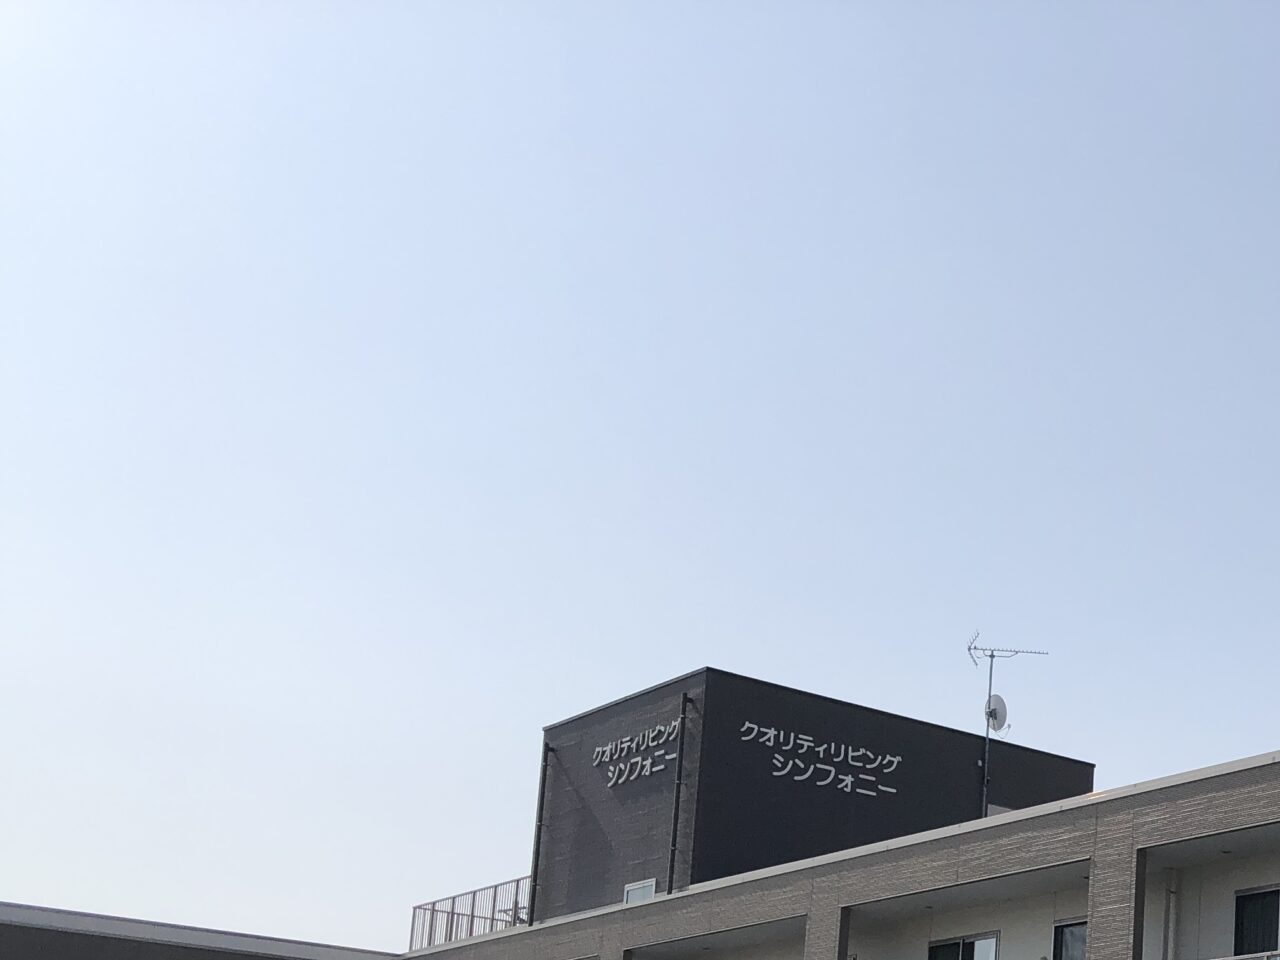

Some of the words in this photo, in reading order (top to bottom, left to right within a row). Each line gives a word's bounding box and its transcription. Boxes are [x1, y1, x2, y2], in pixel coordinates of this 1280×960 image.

[592, 717, 681, 767] クオリティリビング
[739, 720, 903, 774] クオリティリビング
[606, 750, 678, 788] シンフォニー
[771, 752, 898, 797] シンフォニー
